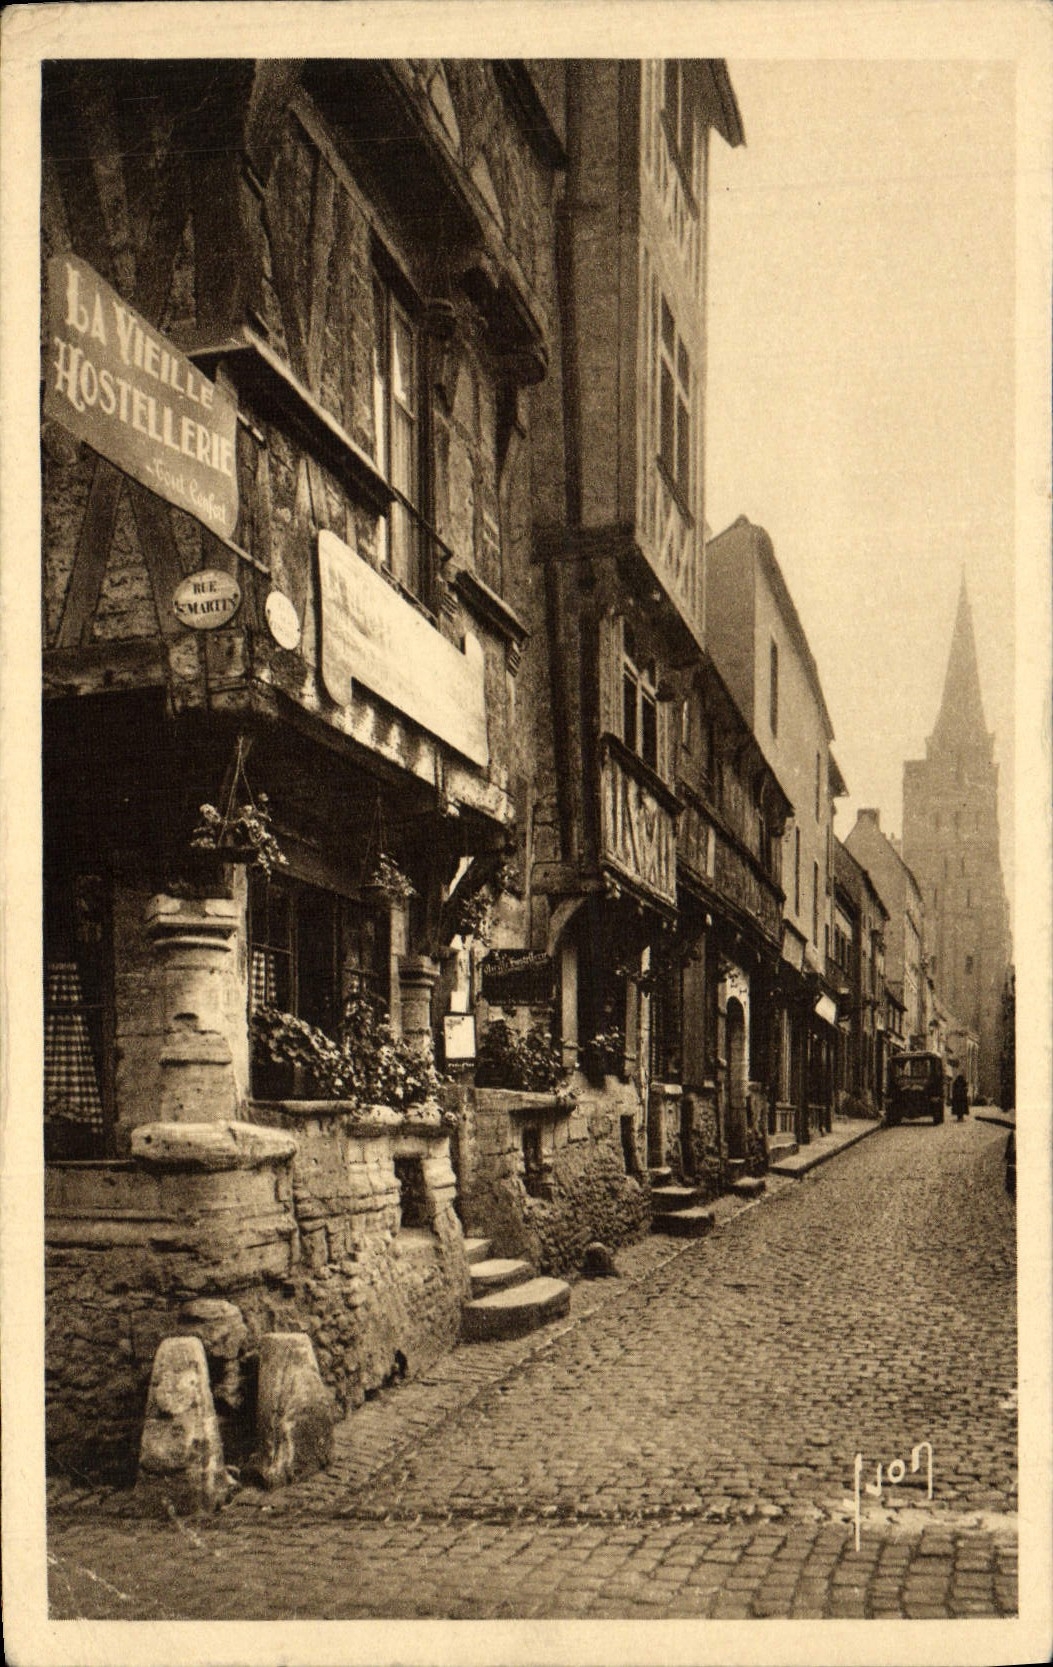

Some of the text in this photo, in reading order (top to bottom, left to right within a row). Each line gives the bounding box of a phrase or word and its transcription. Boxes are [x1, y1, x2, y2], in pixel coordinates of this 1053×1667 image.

[53, 336, 234, 477] HOSTELLERIE
[65, 262, 216, 410] LA VIEILLE
[193, 580, 218, 595] RUE
